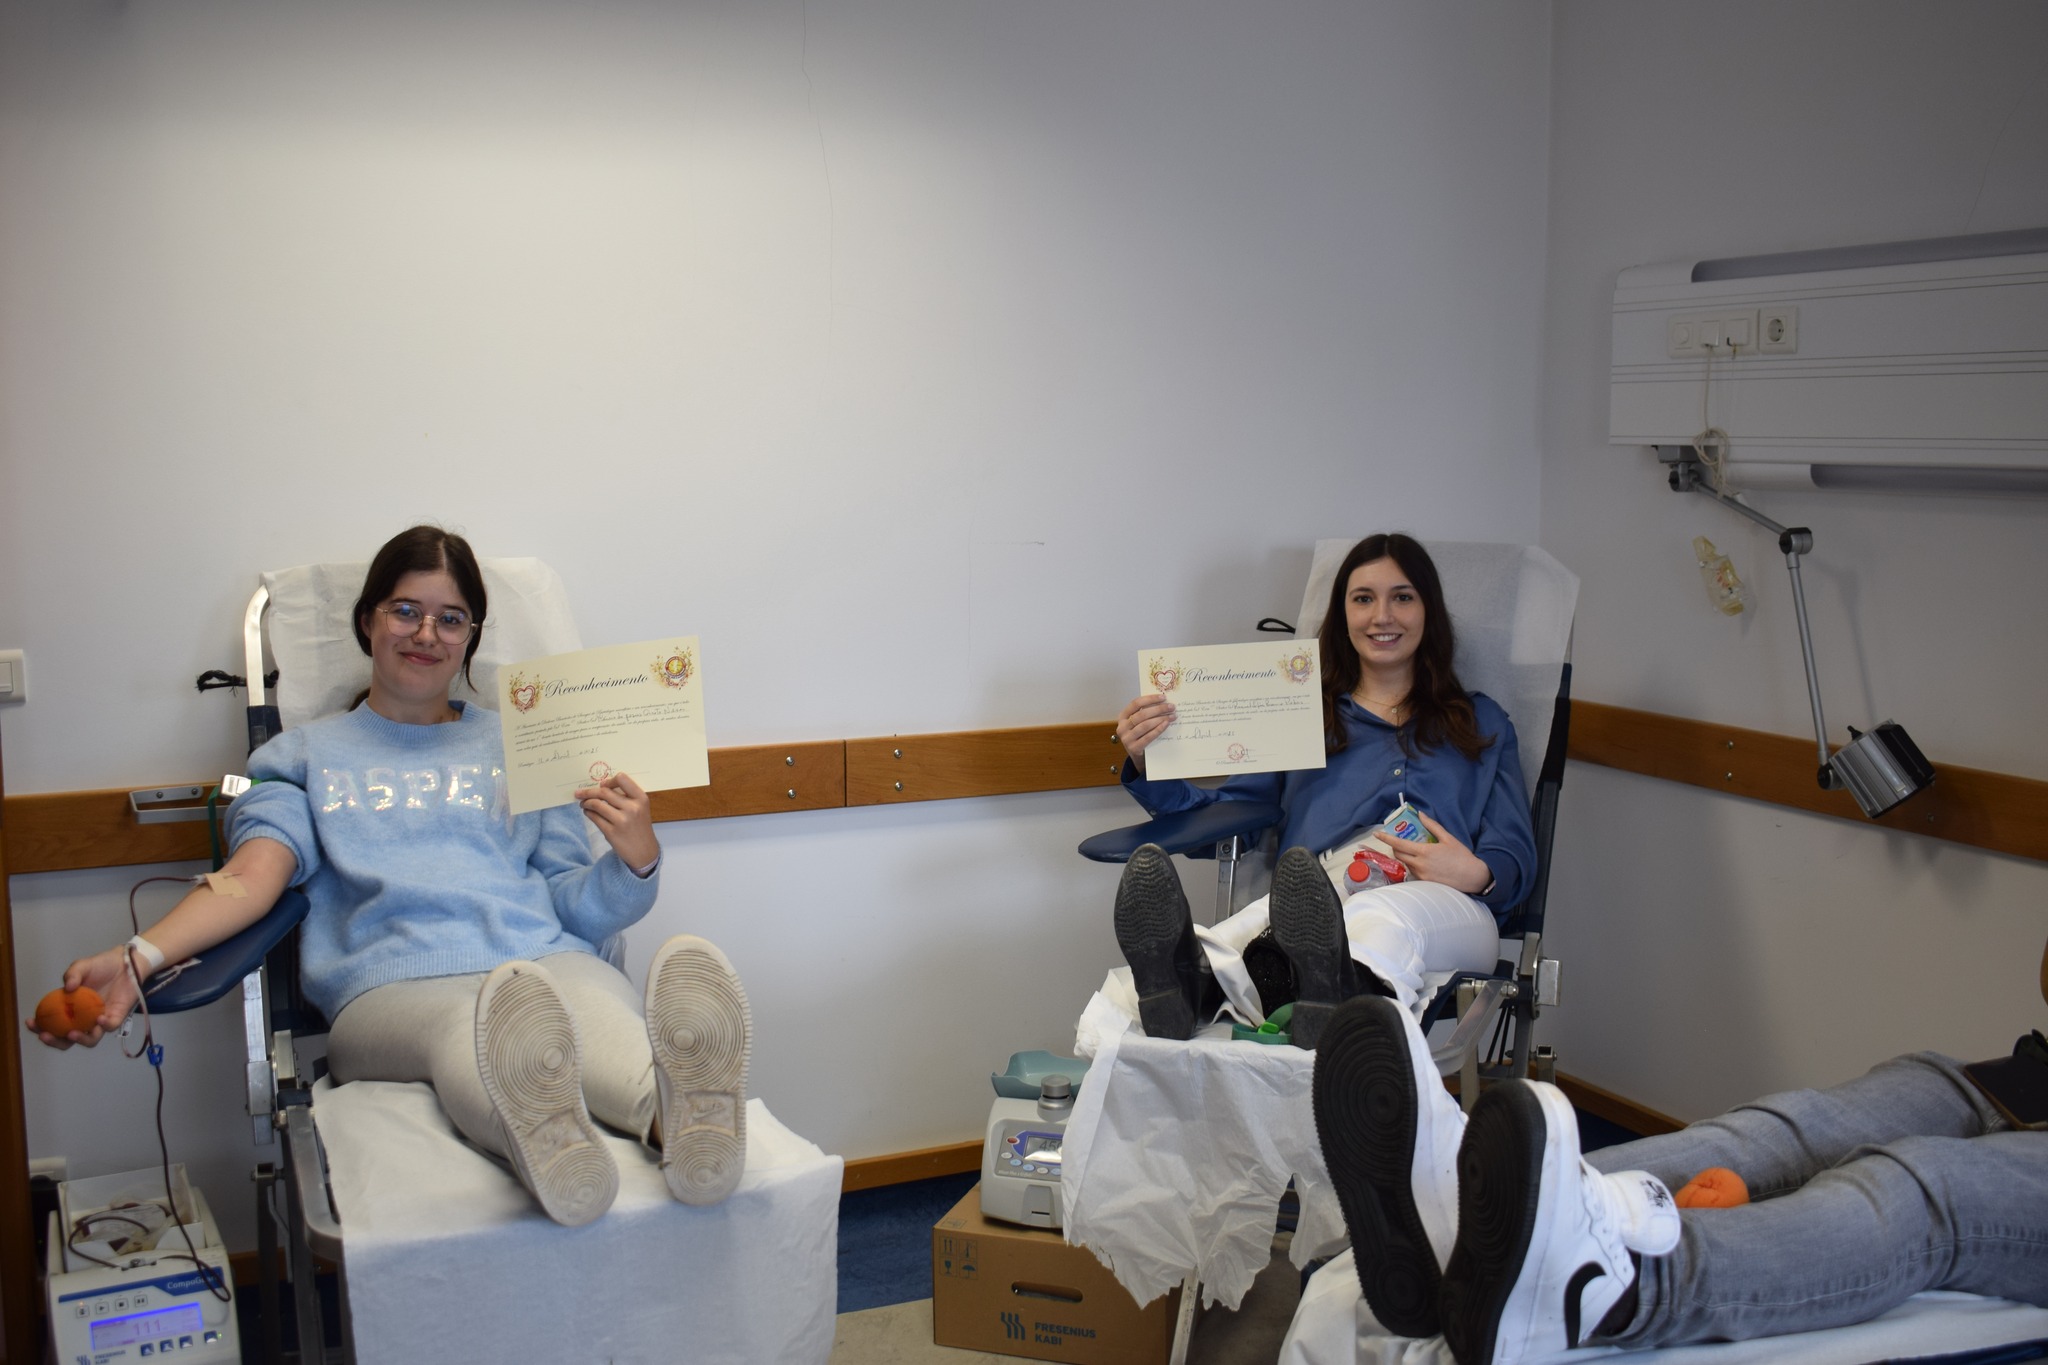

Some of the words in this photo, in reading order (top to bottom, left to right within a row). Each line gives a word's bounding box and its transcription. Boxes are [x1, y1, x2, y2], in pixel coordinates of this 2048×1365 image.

[1185, 668, 1278, 684] Reconhecimento
[544, 674, 649, 699] Reconhecimento
[1035, 1322, 1096, 1339] FRESENIUS
[1035, 1334, 1062, 1345] KABI
